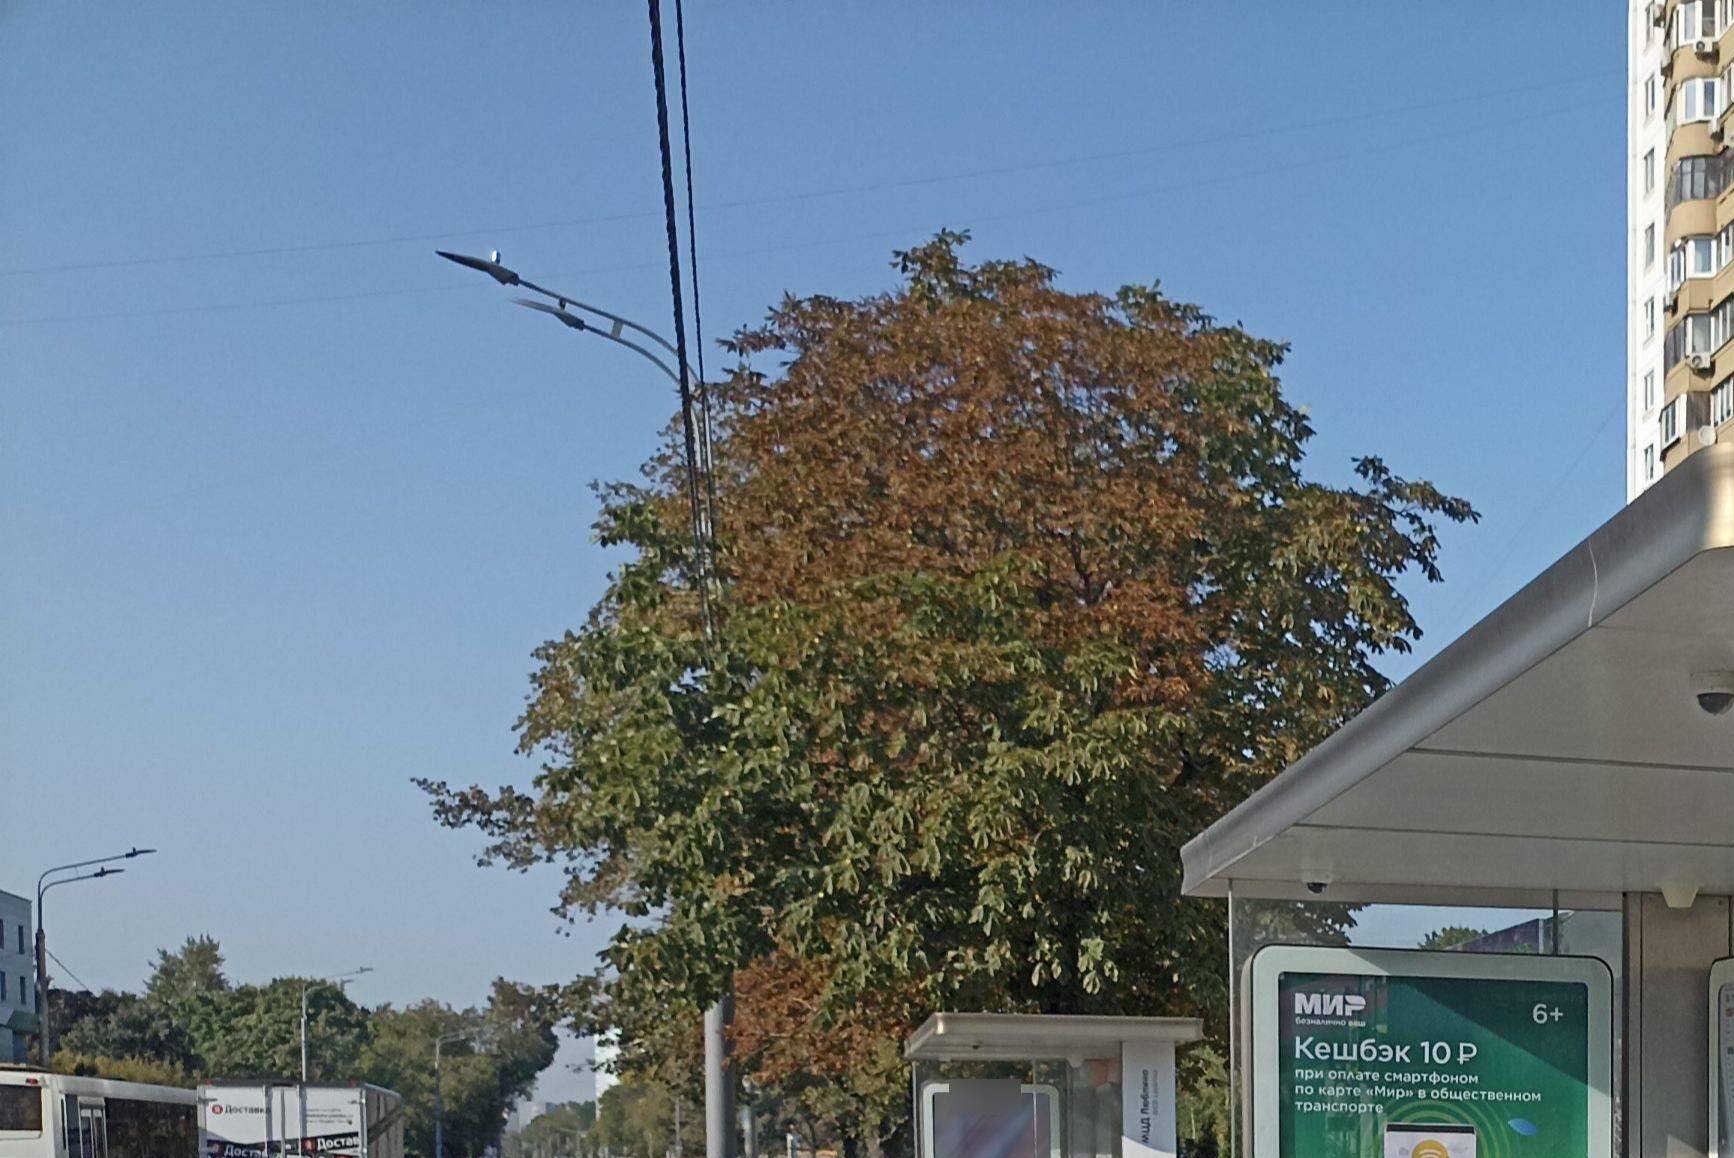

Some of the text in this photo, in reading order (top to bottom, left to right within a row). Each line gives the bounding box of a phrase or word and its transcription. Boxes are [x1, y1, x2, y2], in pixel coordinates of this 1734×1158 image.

[1295, 993, 1366, 1016] МИР
[1532, 1004, 1563, 1024] 6+
[1295, 1036, 1411, 1063] Кешбэк
[1420, 1041, 1451, 1064] 10
[1295, 1069, 1478, 1085] при оплате смартфоном
[1295, 1085, 1314, 1095] по
[1318, 1086, 1361, 1098] карте
[1418, 1089, 1426, 1099] в
[1430, 1087, 1541, 1101] общественном
[1294, 1102, 1384, 1114] транспорте
